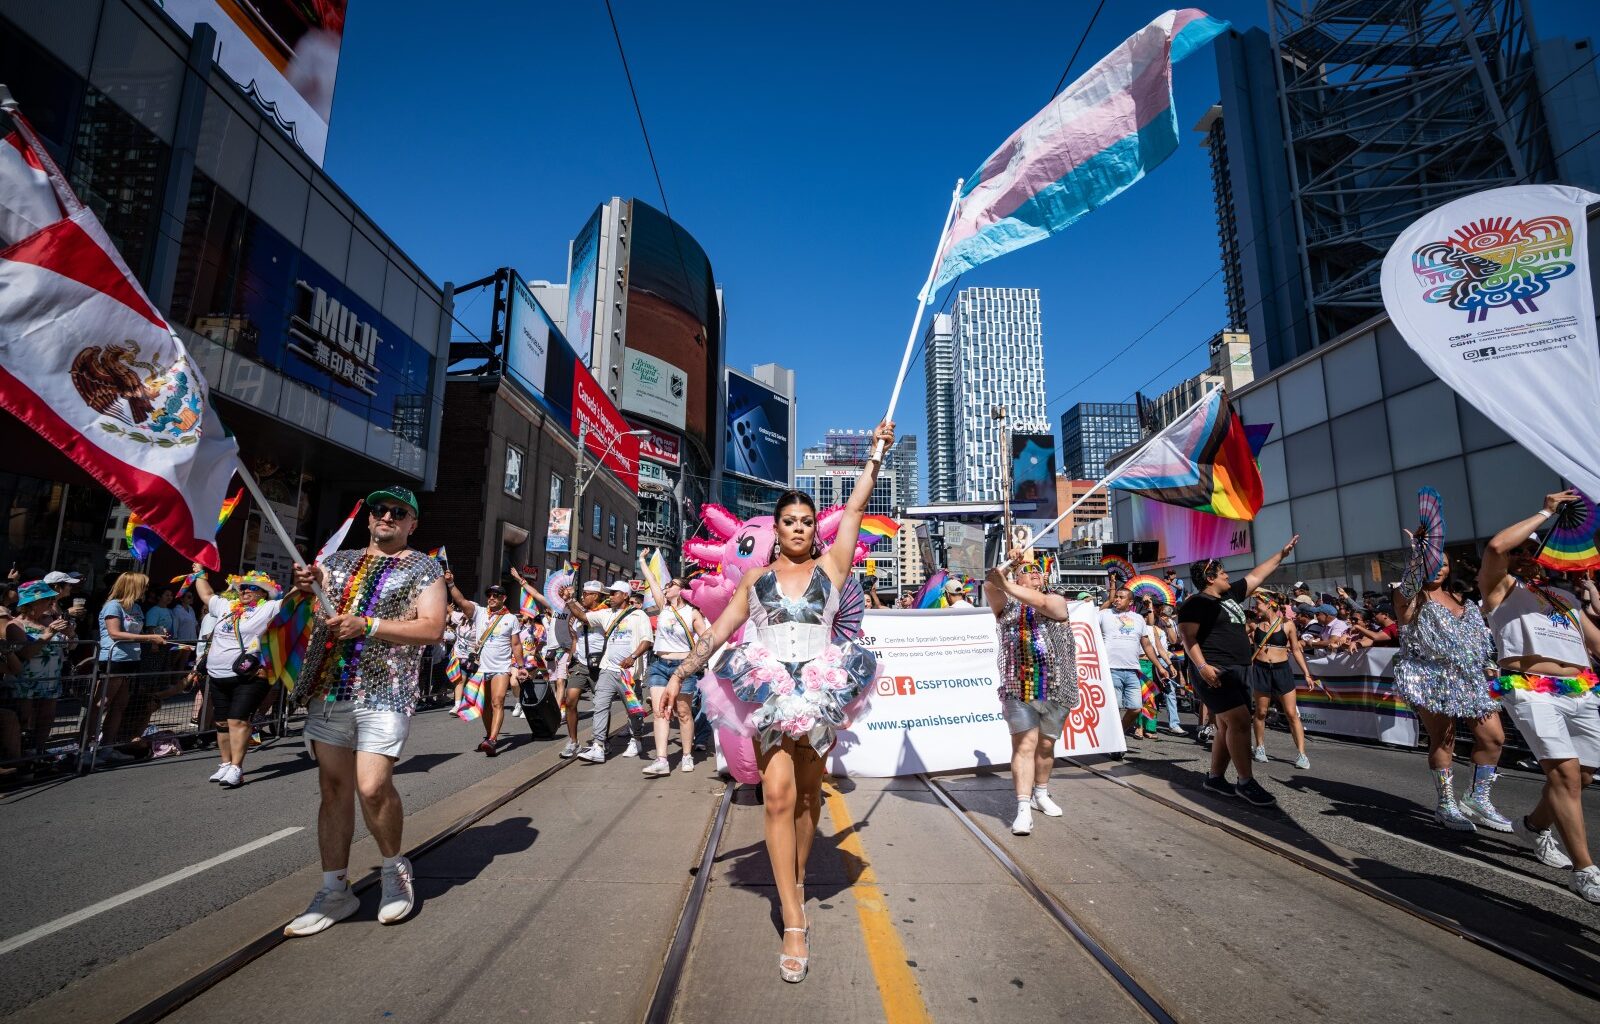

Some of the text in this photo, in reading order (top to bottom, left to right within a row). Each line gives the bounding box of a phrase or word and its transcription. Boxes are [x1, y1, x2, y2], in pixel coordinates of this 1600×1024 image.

[311, 287, 378, 366] MUJI
[1449, 333, 1472, 342] CSSP
[1450, 339, 1476, 348] CGHH
[1498, 333, 1577, 351] CSSPTORONTO
[1472, 344, 1568, 363] www.spanishservices.org
[314, 340, 366, 389] 無印良品
[631, 362, 656, 376] Edward
[640, 372, 659, 384] Island
[578, 381, 600, 419] Canada's
[1013, 420, 1052, 433] Citytv
[637, 521, 675, 538] NERS
[1230, 529, 1246, 551] H&M
[916, 635, 938, 644] Spanish
[939, 634, 965, 644] Speaking
[966, 633, 989, 642] Peoples
[925, 649, 943, 657] Gente
[954, 647, 971, 655] Habla
[972, 646, 993, 656] Hispana
[915, 677, 992, 690] CSSPTORONTO
[867, 712, 1004, 731] www.spanishservices.o
